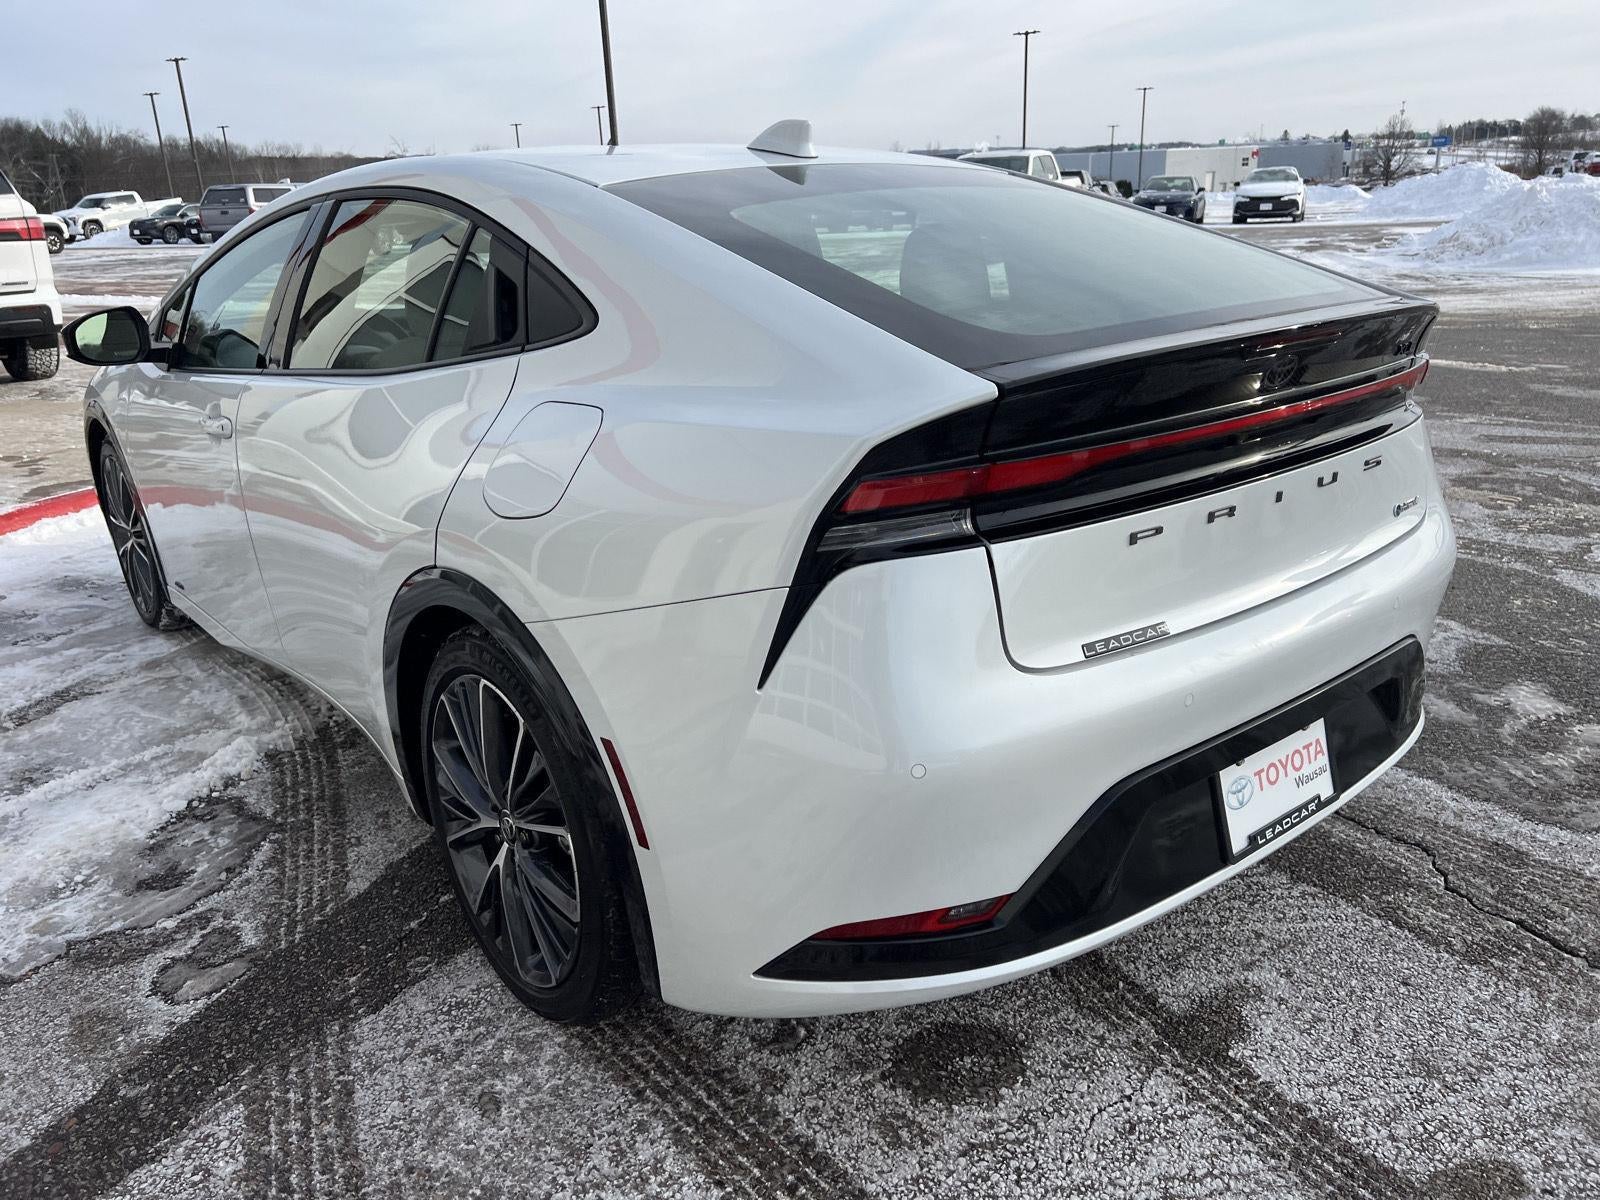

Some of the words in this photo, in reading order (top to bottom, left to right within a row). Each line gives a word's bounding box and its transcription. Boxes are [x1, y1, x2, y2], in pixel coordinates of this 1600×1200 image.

[1129, 455, 1382, 546] PRIUS
[1083, 624, 1169, 656] LEADCAR
[1253, 738, 1325, 791] TOYOTA
[1294, 763, 1328, 789] Wausau
[1257, 801, 1318, 844] LEADCAR
